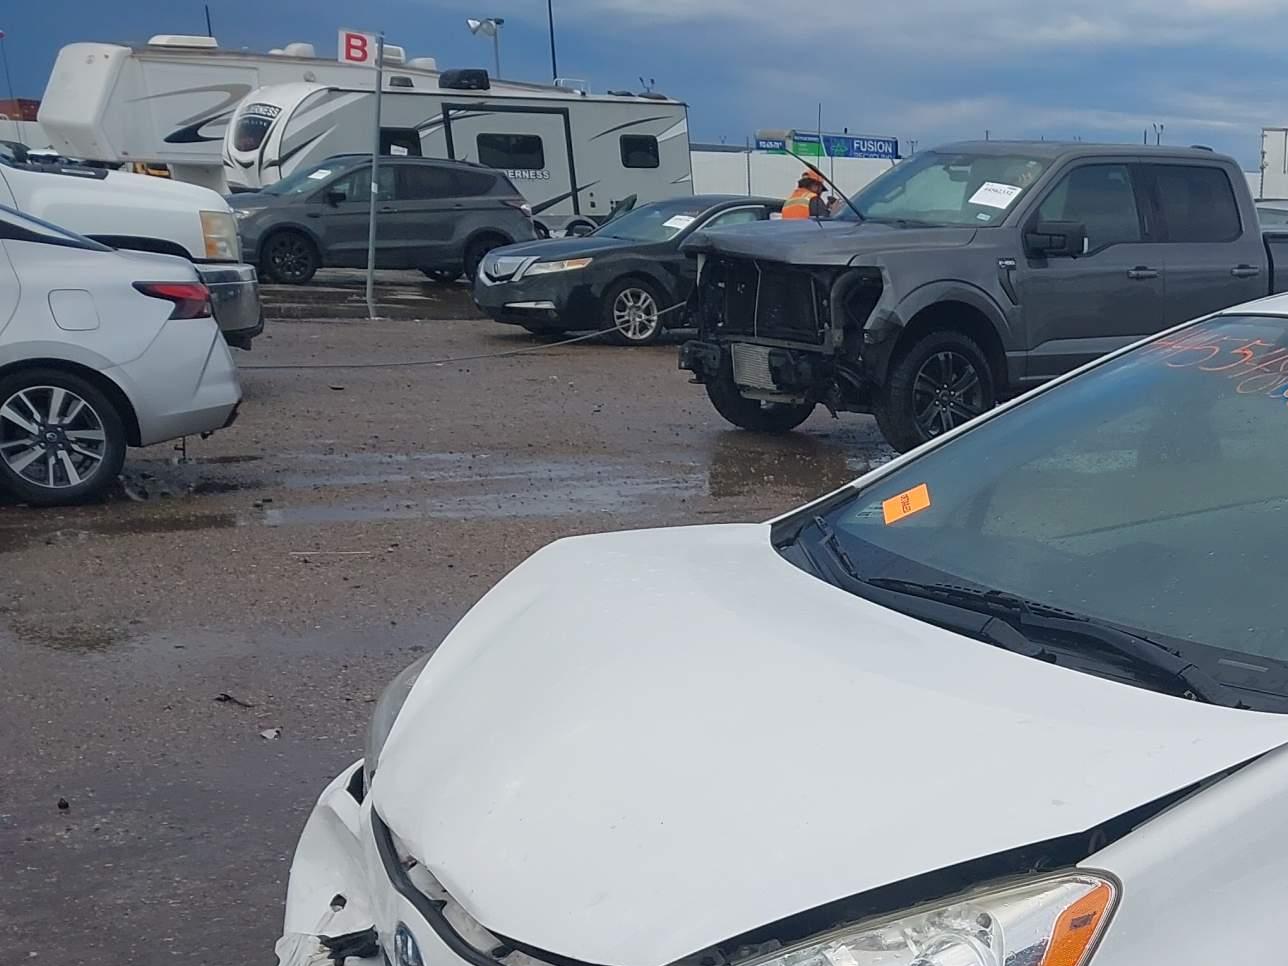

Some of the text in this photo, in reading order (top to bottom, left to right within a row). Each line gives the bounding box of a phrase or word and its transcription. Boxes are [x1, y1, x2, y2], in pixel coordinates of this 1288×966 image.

[345, 32, 368, 62] B
[852, 139, 893, 153] FUSION
[503, 169, 550, 179] ERNESS
